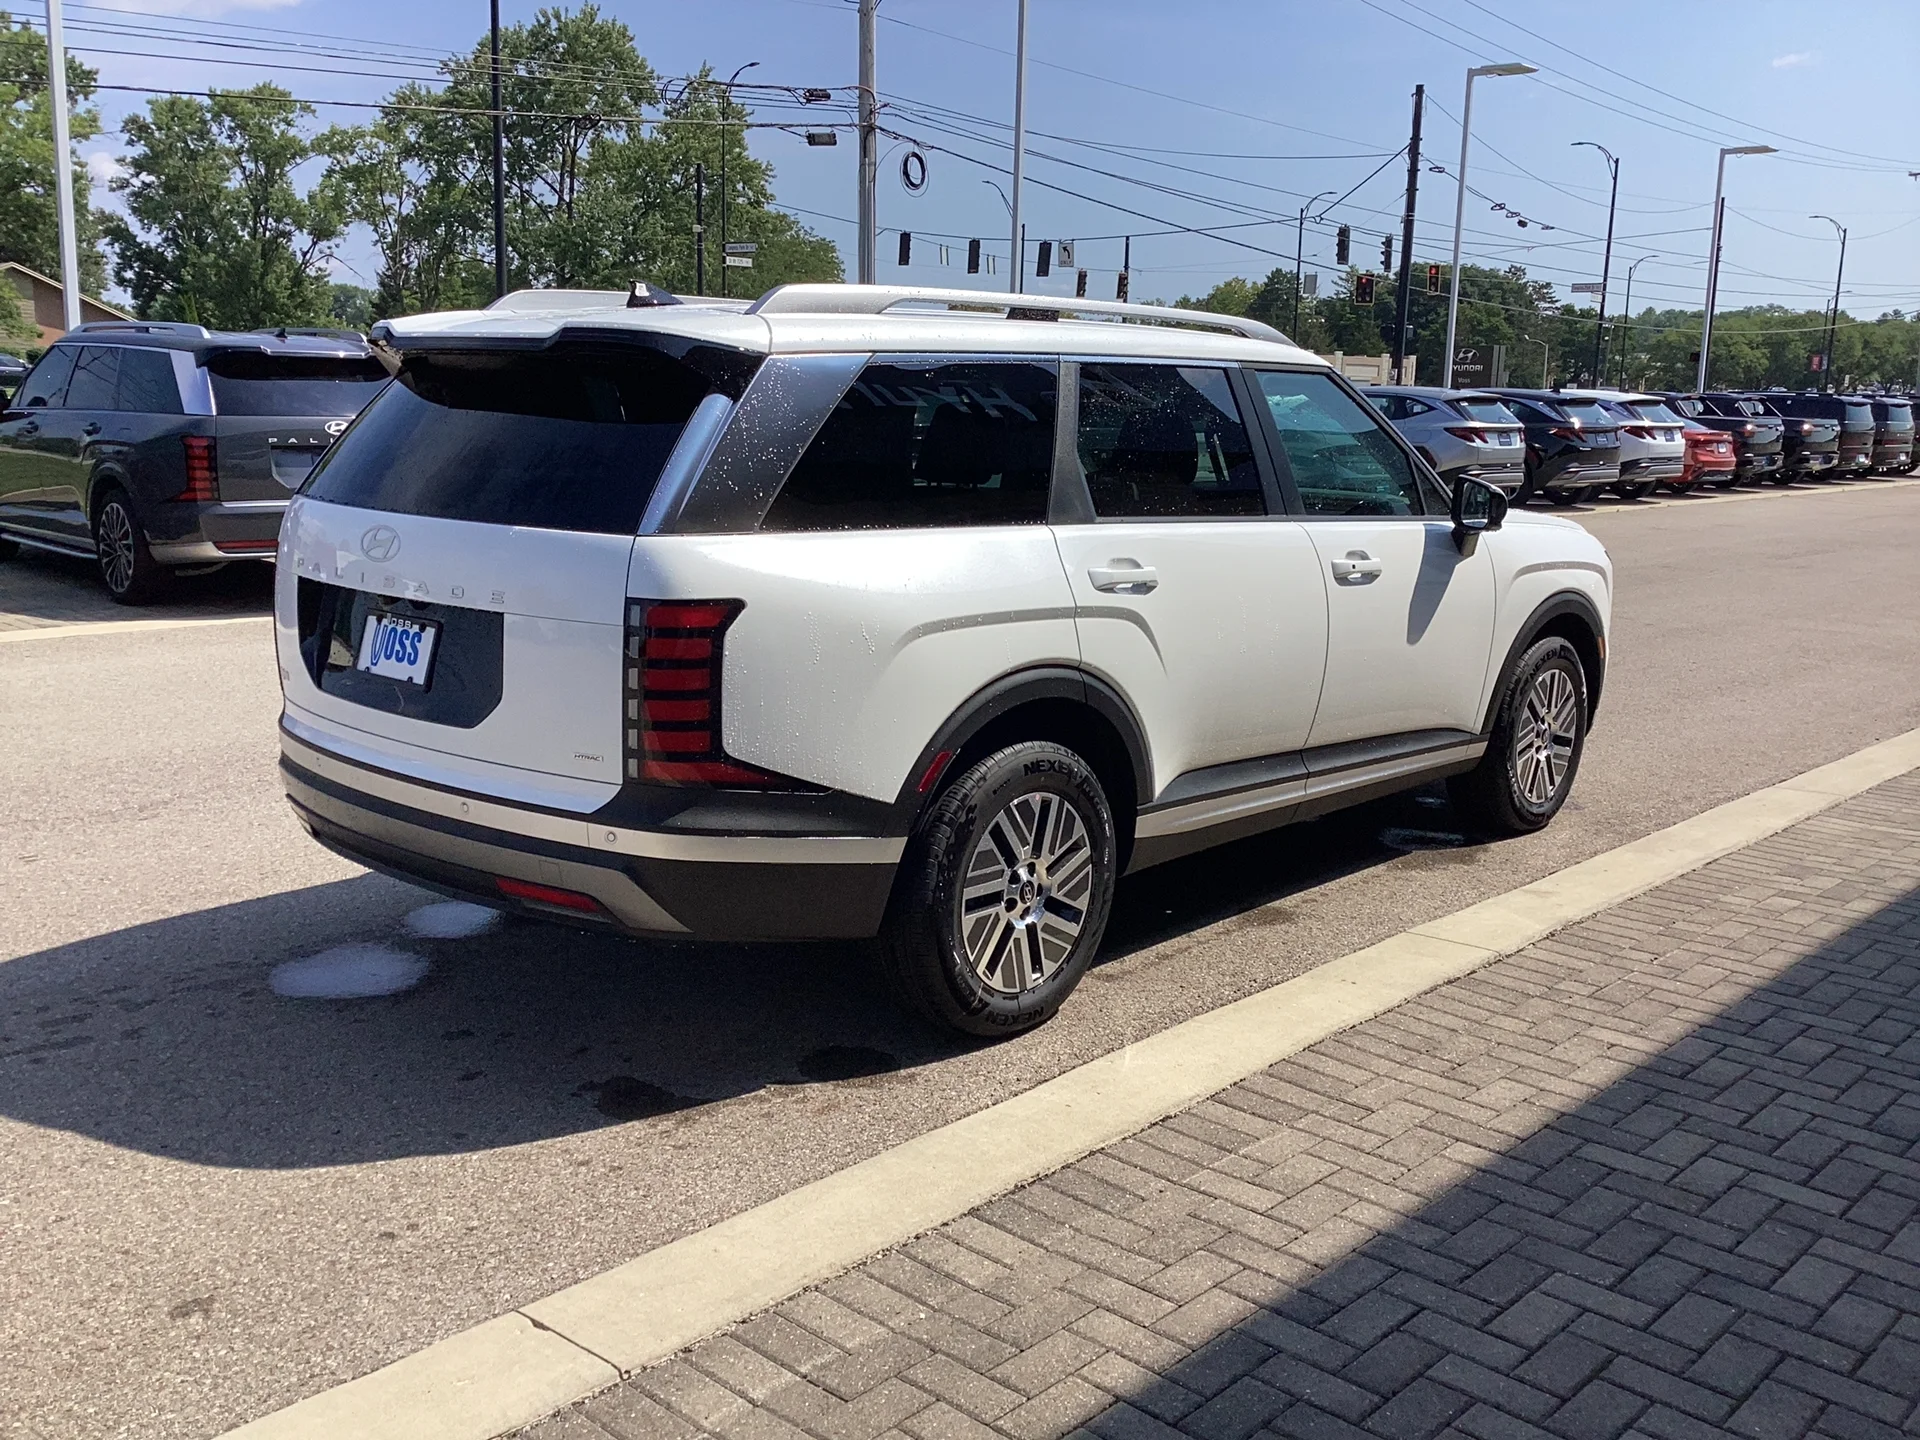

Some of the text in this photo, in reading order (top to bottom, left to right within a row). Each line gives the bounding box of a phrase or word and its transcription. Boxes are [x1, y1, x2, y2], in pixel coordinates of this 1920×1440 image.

[1453, 364, 1483, 372] YUNDAI
[297, 557, 505, 605] PALISADE
[370, 623, 423, 667] VOSS
[574, 754, 602, 762] HTRAC
